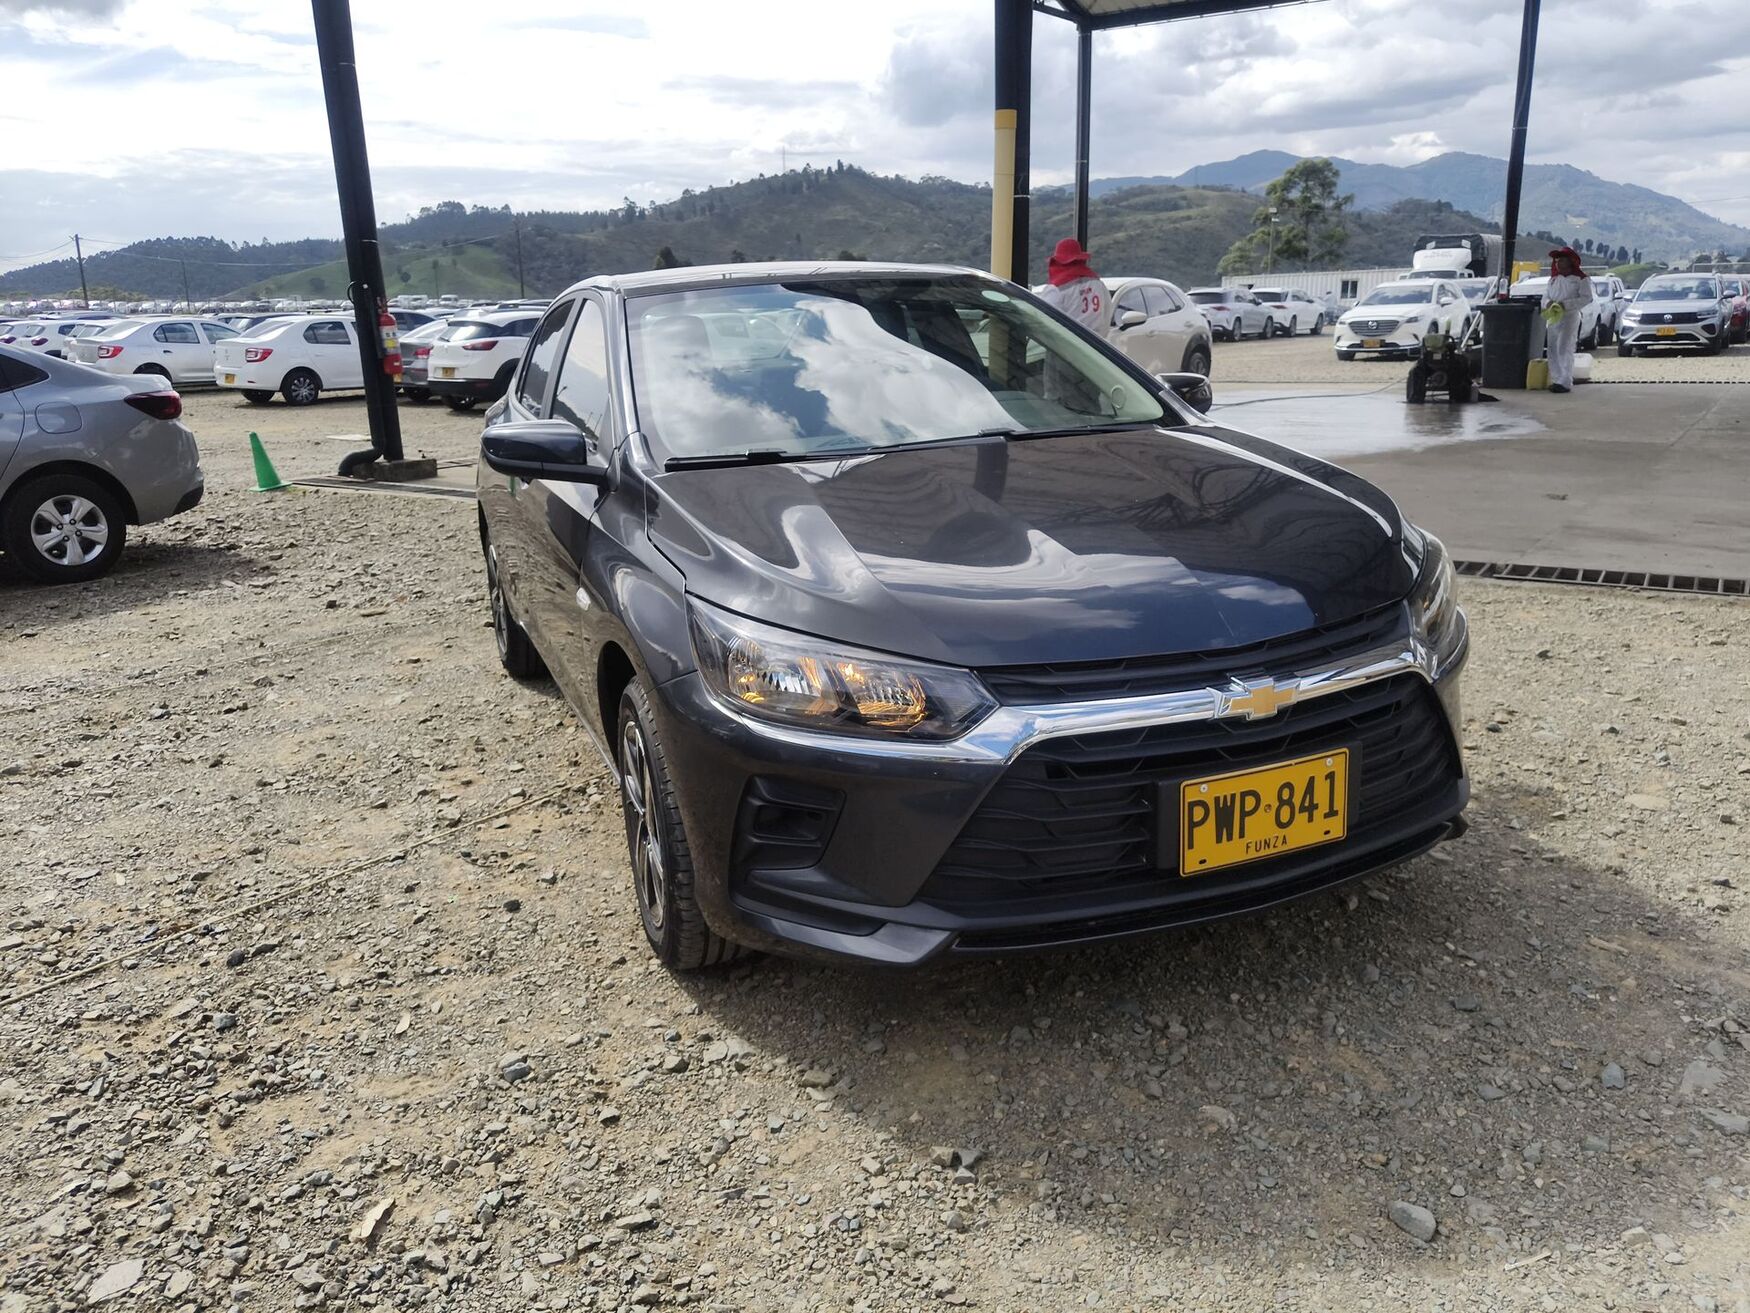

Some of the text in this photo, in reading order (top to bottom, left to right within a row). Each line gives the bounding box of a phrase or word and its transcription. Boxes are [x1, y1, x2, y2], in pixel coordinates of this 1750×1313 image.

[1081, 295, 1100, 313] 39
[1187, 770, 1339, 850] PWP 841
[1245, 834, 1288, 854] FUNZA
